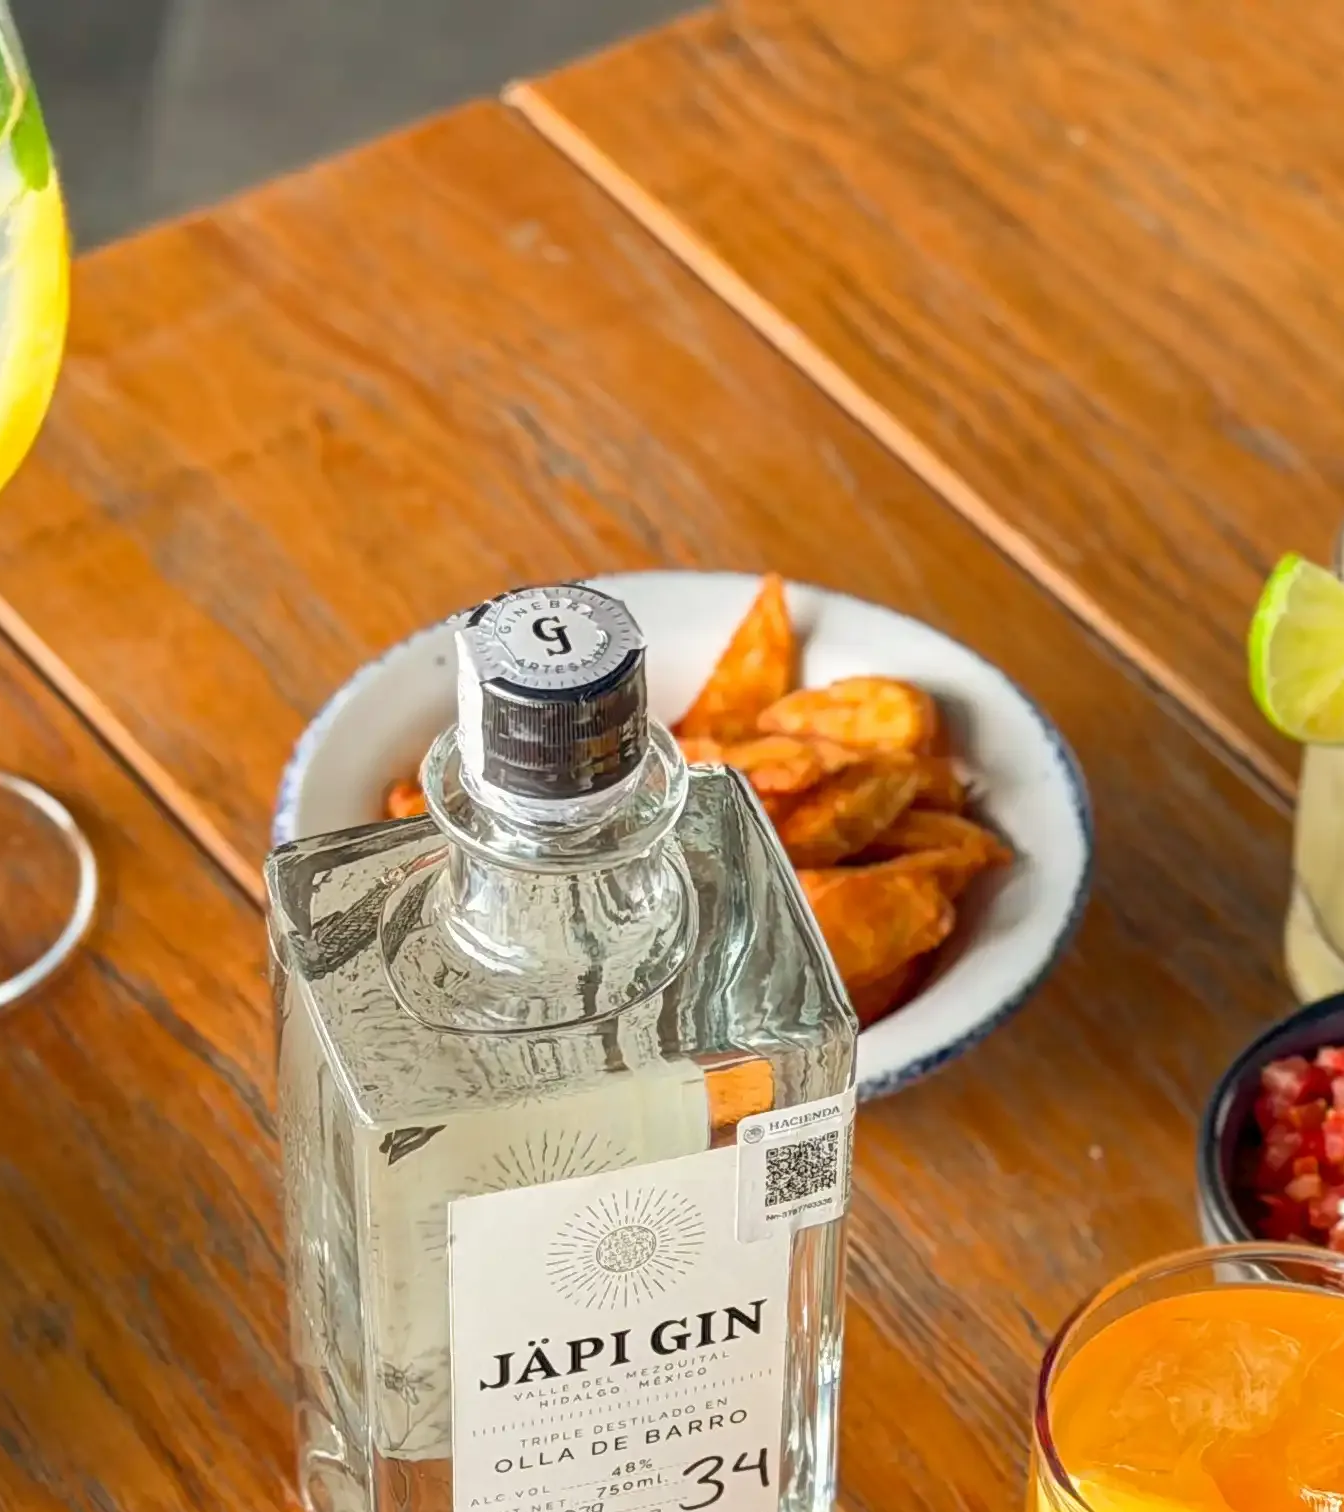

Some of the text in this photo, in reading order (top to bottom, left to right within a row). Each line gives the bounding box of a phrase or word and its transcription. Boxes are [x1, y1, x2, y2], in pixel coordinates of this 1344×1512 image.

[498, 599, 595, 634] GINEBRA
[769, 1105, 840, 1131] HACIENDA
[479, 1298, 768, 1392] JÄPI GIN
[513, 1350, 730, 1402] VALLE DEL MEZQUITAL
[638, 1367, 708, 1389] MÉXICO
[494, 1409, 749, 1474] OLLA DE BARRO
[520, 1397, 729, 1449] TRIPLE DESTILADO EN
[611, 1458, 653, 1477] 48%
[679, 1448, 770, 1511] 34
